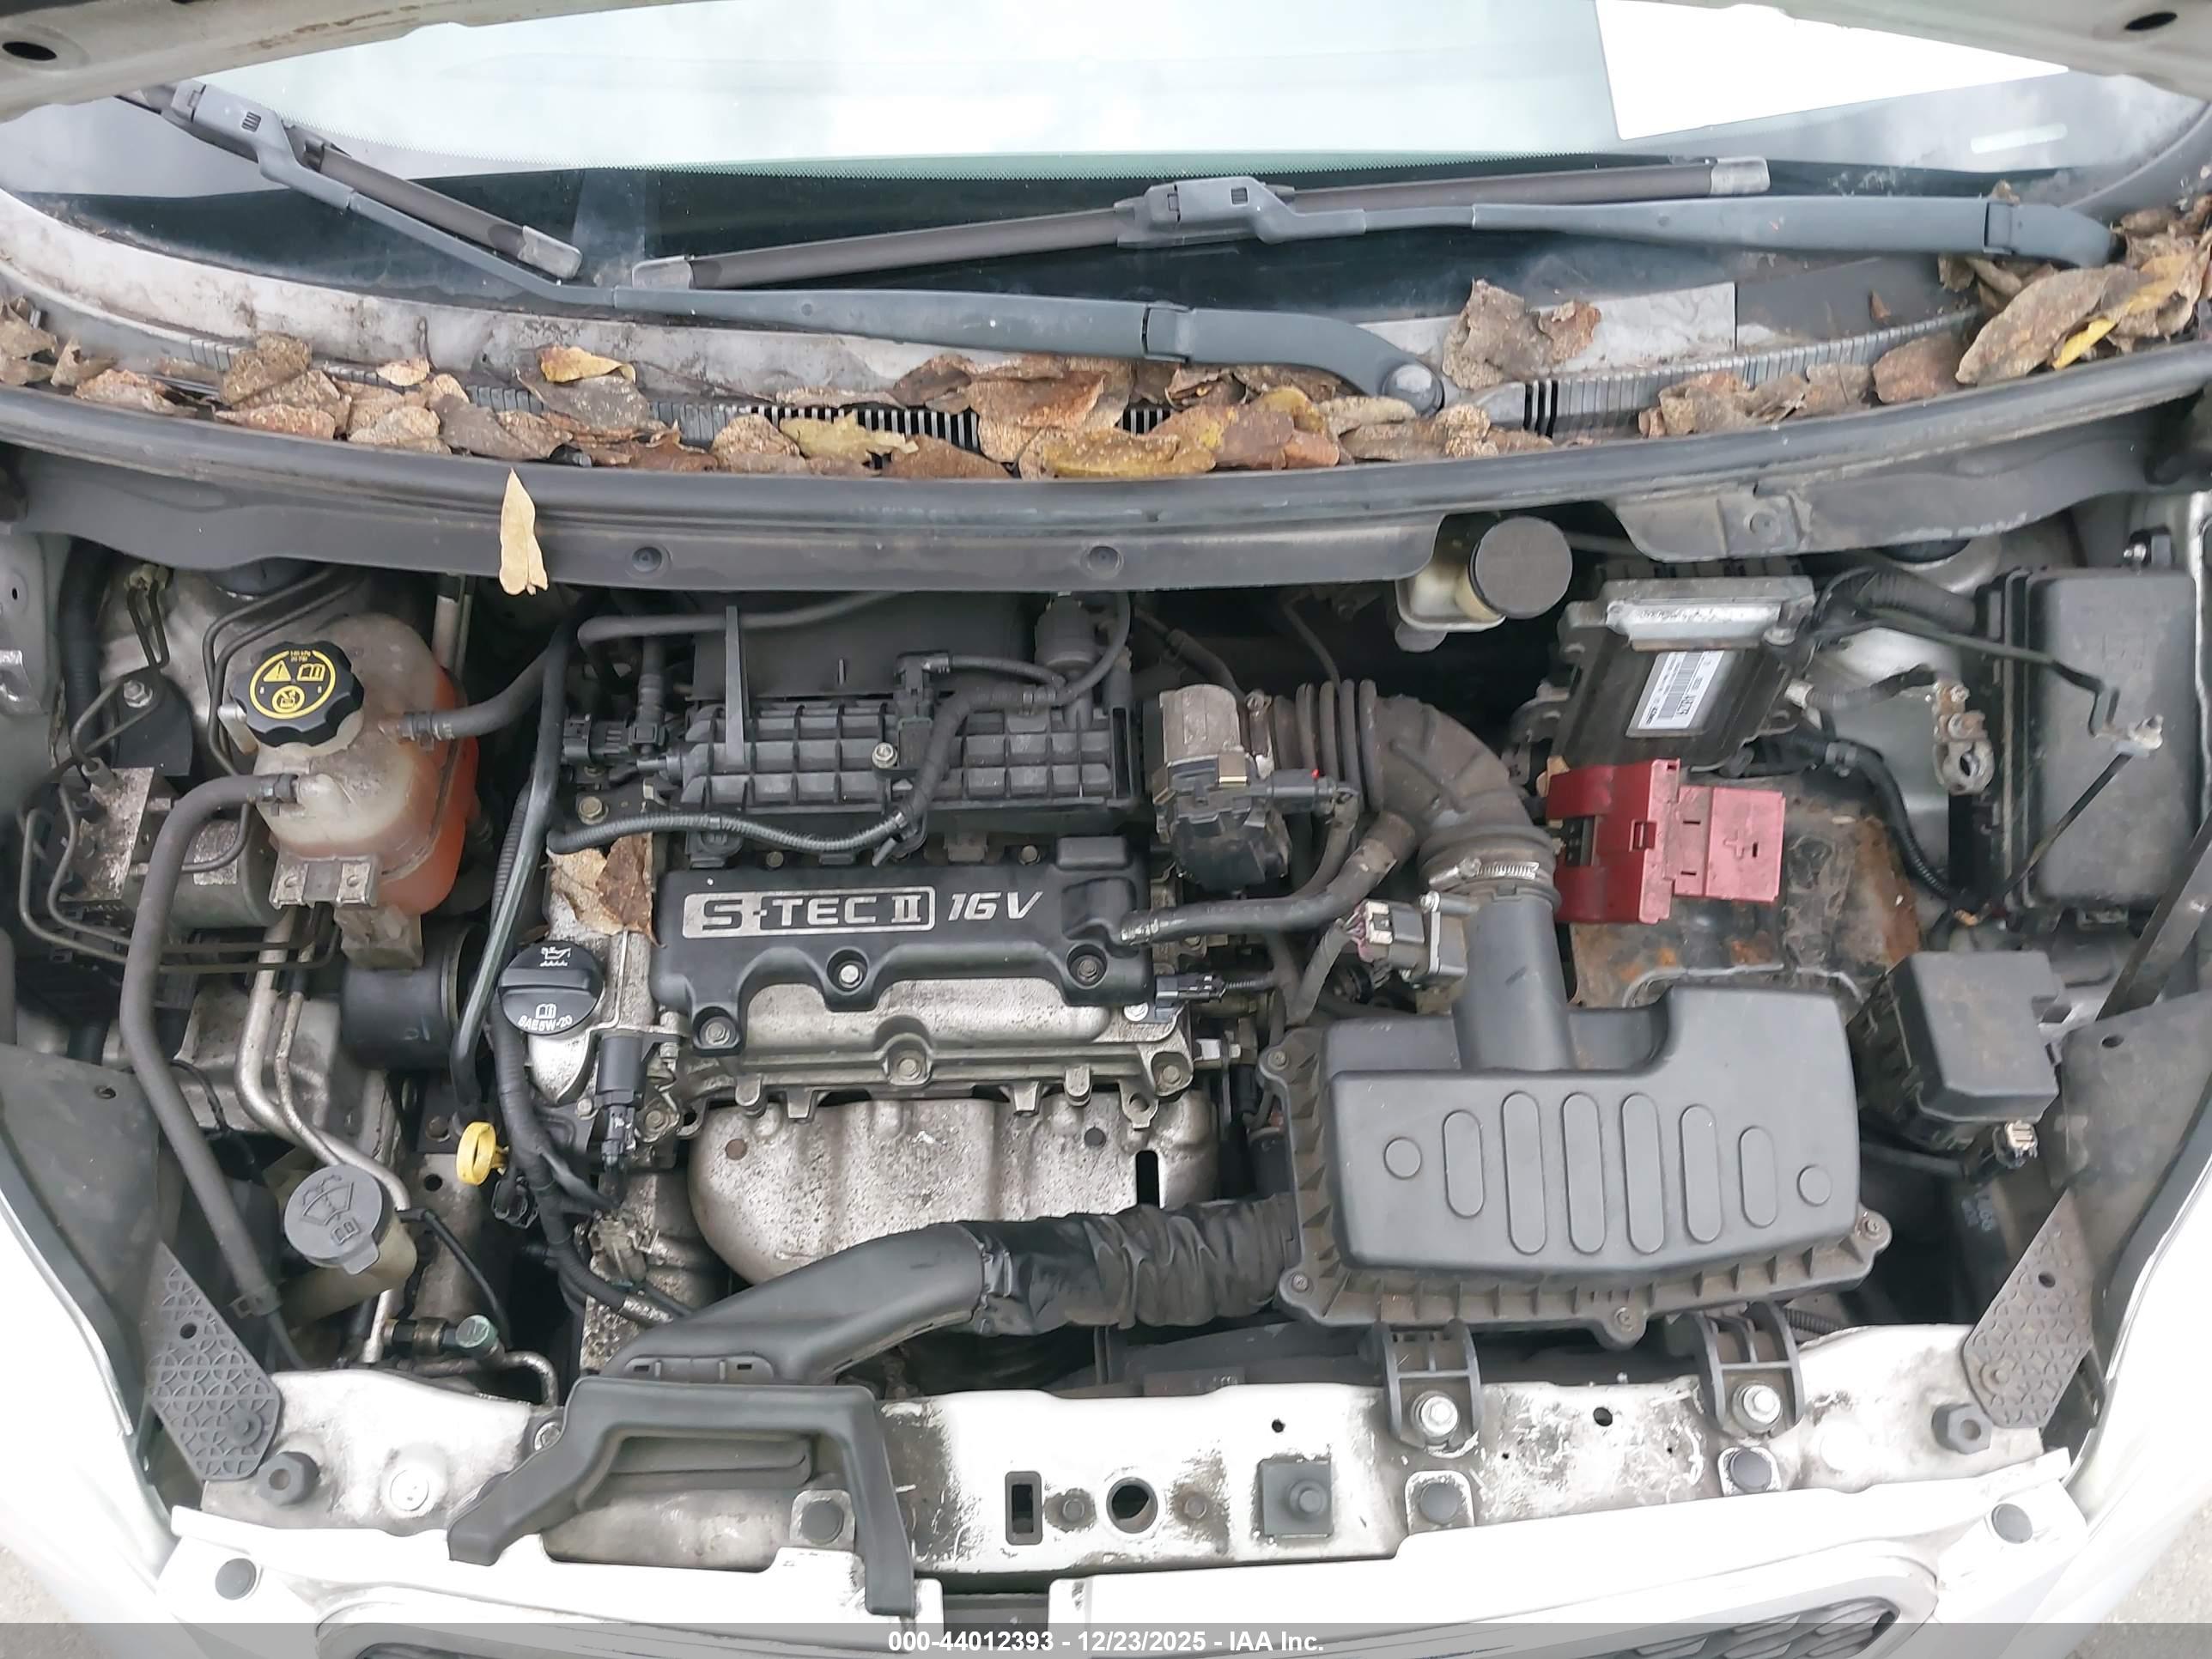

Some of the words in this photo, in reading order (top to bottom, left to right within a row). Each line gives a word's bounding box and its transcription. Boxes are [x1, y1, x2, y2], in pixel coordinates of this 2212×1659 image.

[702, 896, 877, 932] S-TEC
[891, 894, 922, 923] II
[948, 891, 1043, 921] 16V
